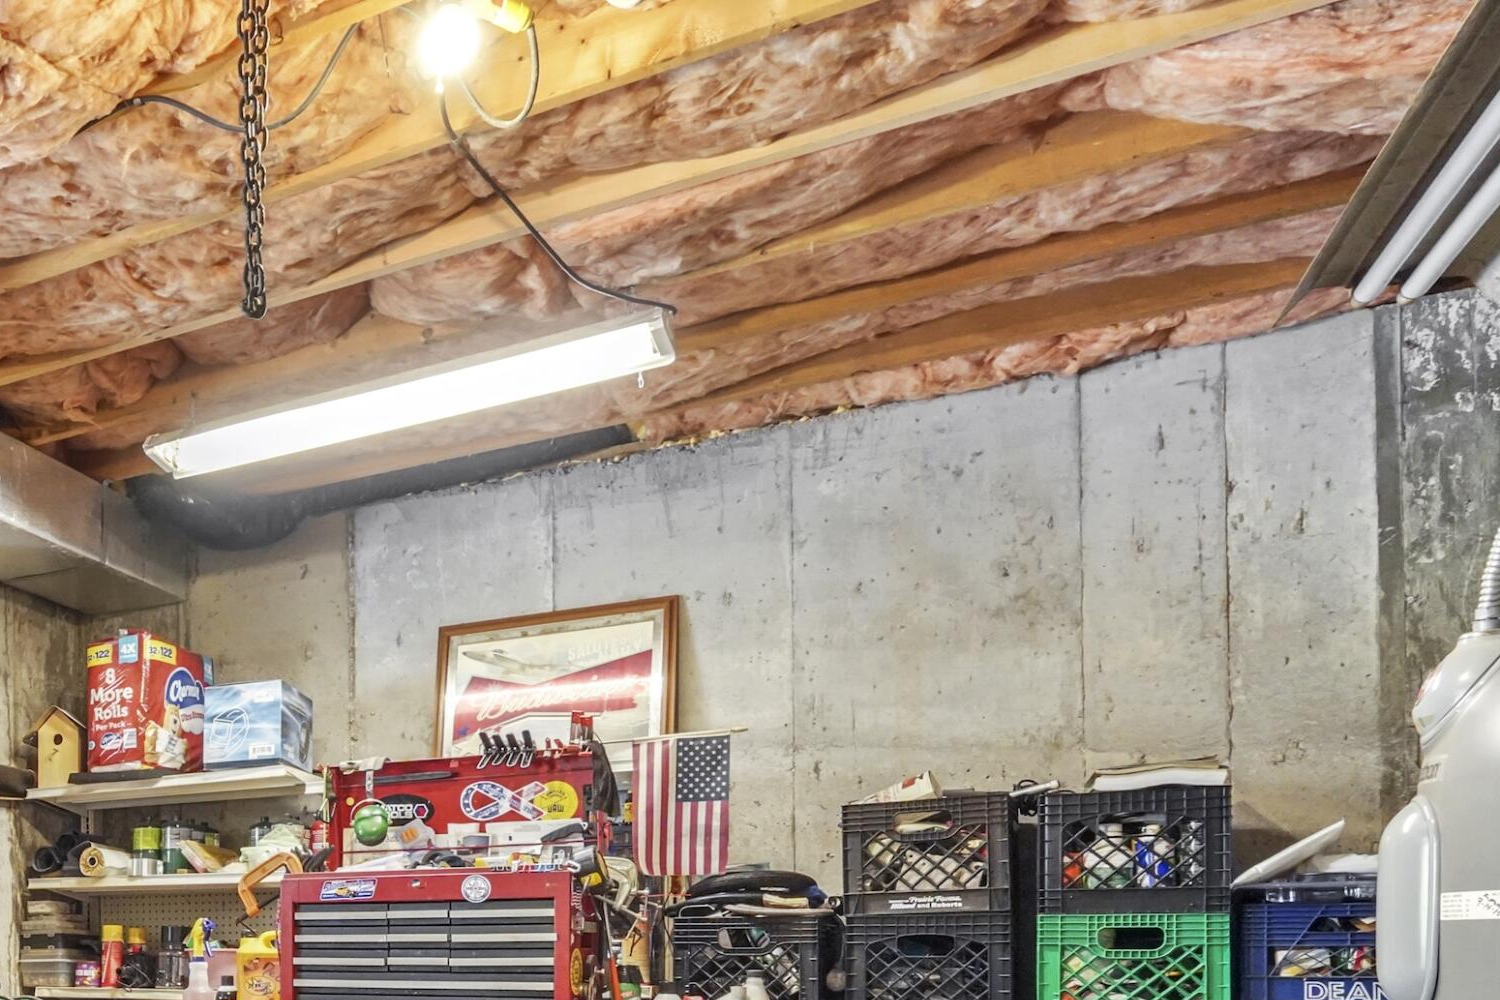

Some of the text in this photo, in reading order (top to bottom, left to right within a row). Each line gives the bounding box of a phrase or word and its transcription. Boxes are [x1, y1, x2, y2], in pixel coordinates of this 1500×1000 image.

[121, 643, 135, 654] 4X
[105, 668, 116, 685] 8
[90, 686, 134, 705] More
[94, 705, 129, 721] Rolls
